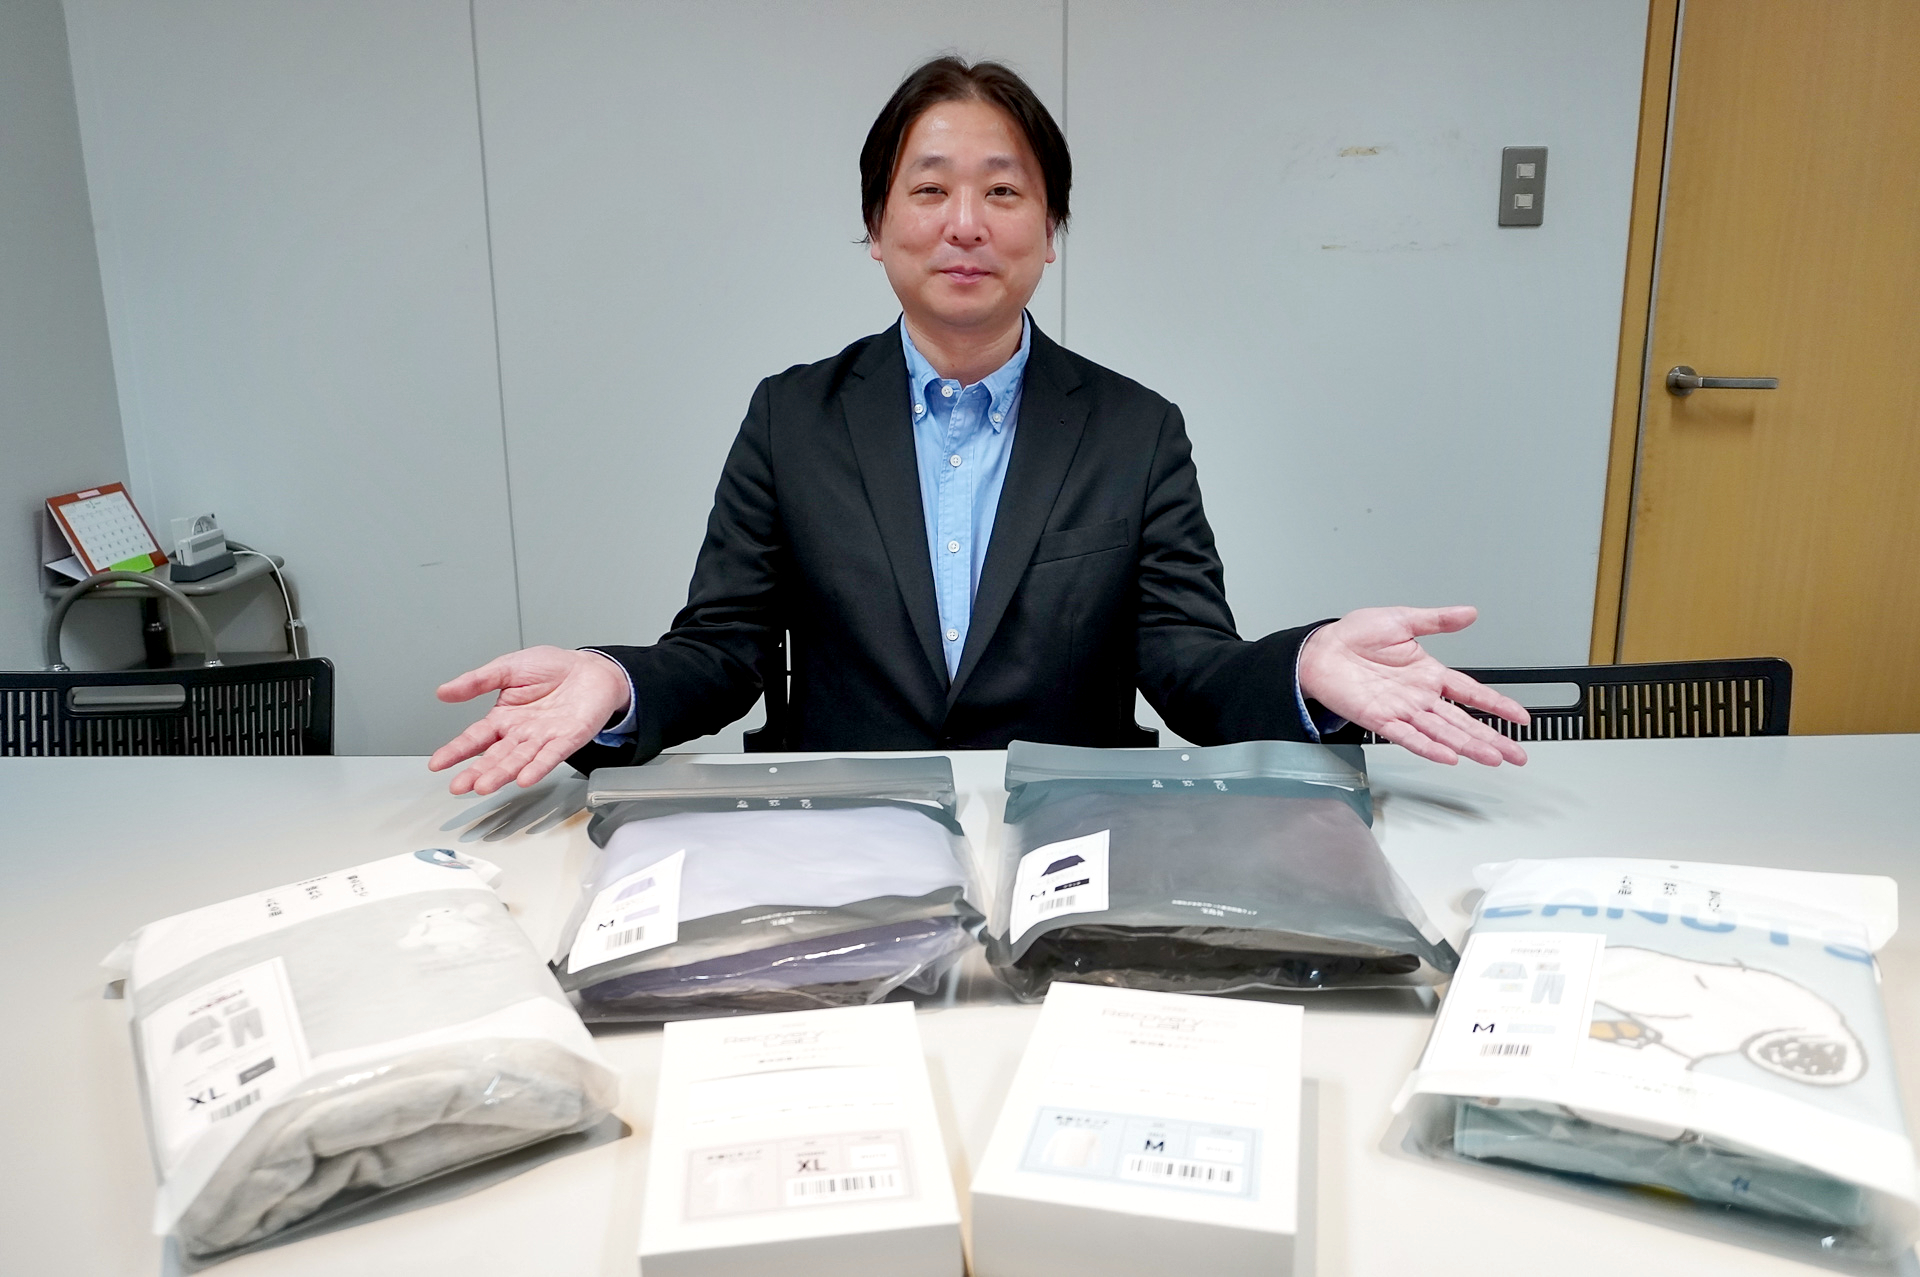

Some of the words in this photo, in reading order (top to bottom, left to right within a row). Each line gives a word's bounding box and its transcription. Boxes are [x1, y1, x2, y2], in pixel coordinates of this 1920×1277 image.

[1030, 890, 1046, 900] M
[596, 919, 615, 931] M
[1472, 1022, 1496, 1034] M
[188, 1087, 228, 1111] XL
[1144, 1139, 1165, 1152] M
[796, 1159, 828, 1172] XL
